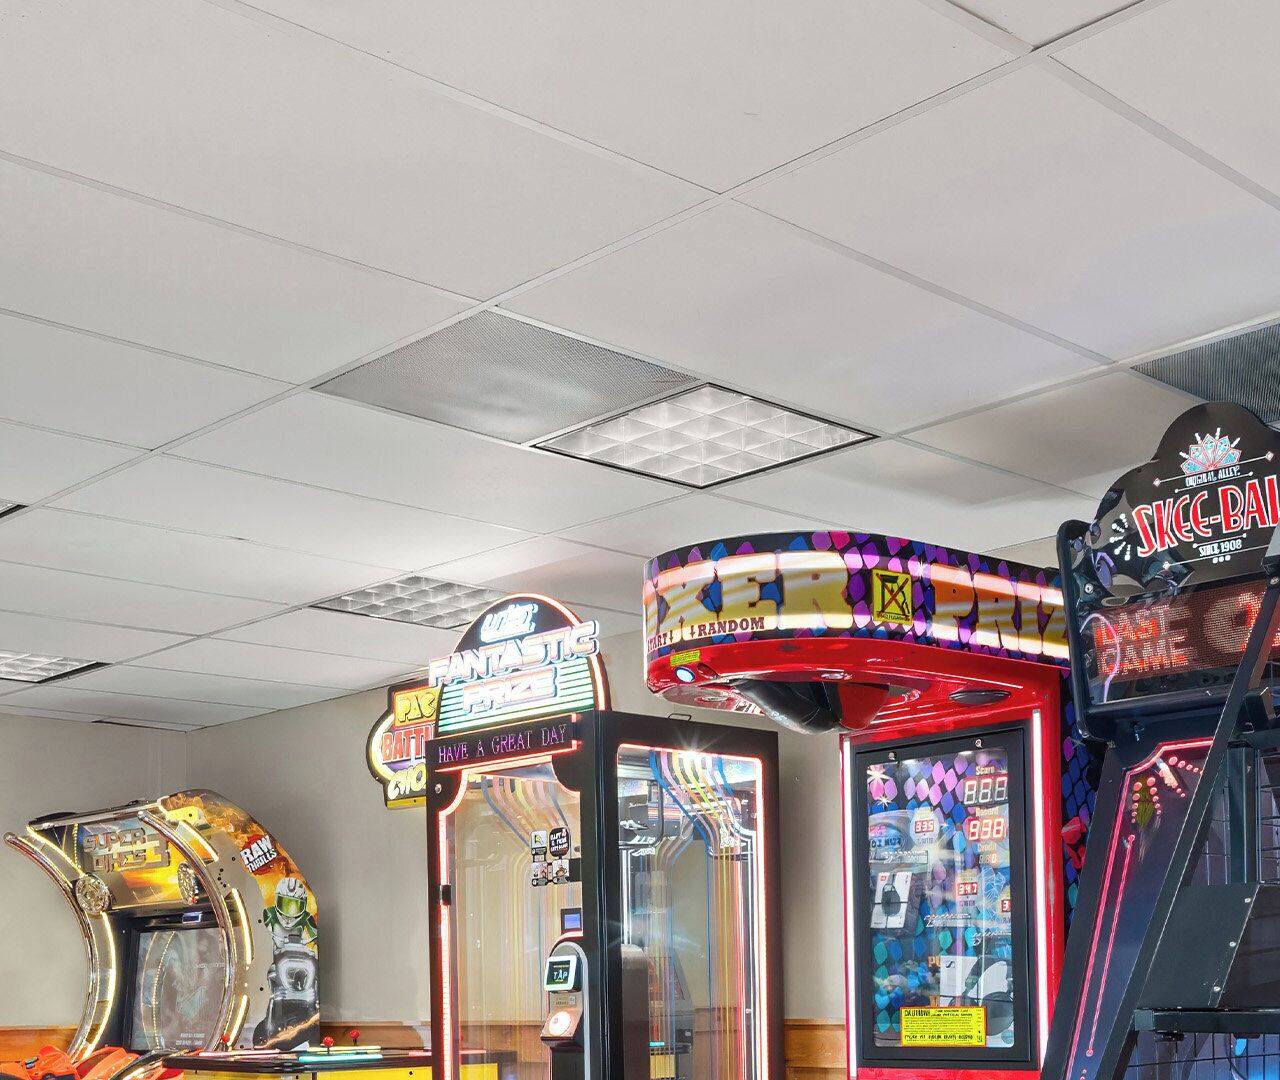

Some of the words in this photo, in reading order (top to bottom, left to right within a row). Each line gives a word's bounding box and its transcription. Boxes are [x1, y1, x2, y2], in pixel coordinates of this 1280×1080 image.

[1221, 540, 1243, 553] 1908
[697, 616, 765, 637] RANDOM
[429, 619, 599, 686] FANTASTIC
[463, 666, 558, 713] PRIZE
[382, 723, 435, 761] BATT
[438, 741, 469, 764] HAVE
[476, 739, 484, 758] A
[491, 729, 533, 754] GREAT
[542, 724, 567, 746] DAY
[388, 765, 427, 799] CHO
[240, 834, 272, 864] RAW
[245, 848, 278, 873] THRILLS
[553, 970, 568, 980] TAP
